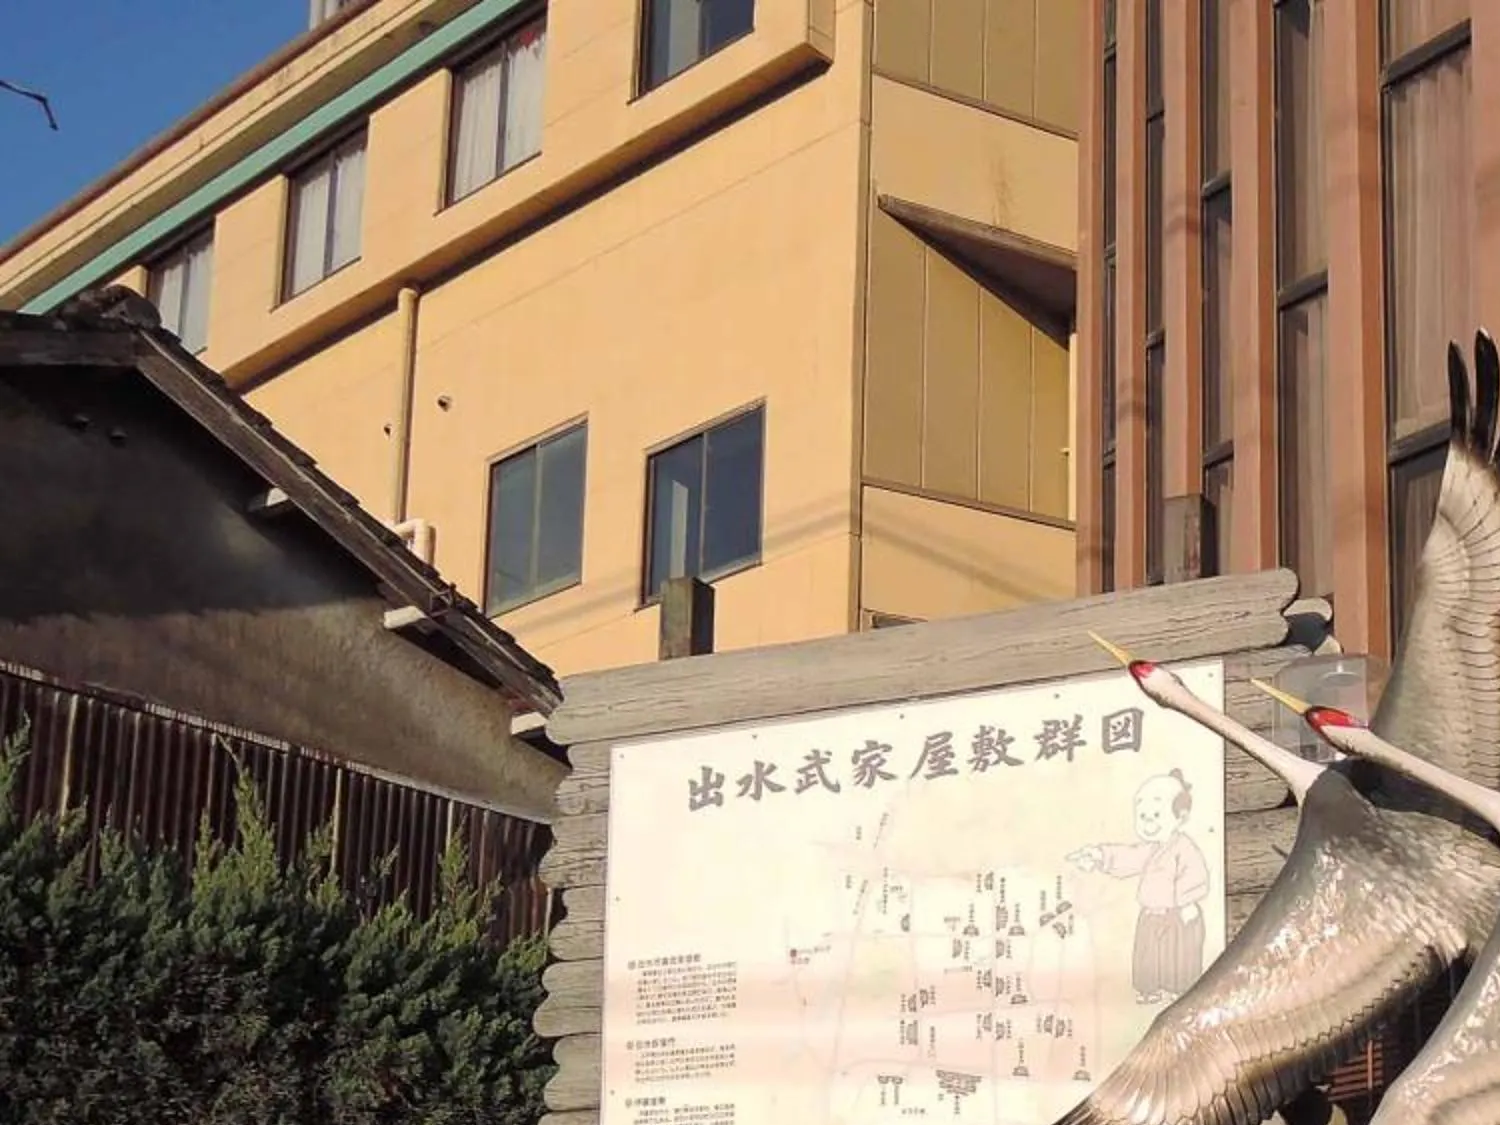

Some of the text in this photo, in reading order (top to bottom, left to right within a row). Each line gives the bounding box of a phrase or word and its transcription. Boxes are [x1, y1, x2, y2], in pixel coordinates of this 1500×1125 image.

[688, 706, 1145, 811] 出水武家屋敷群図
